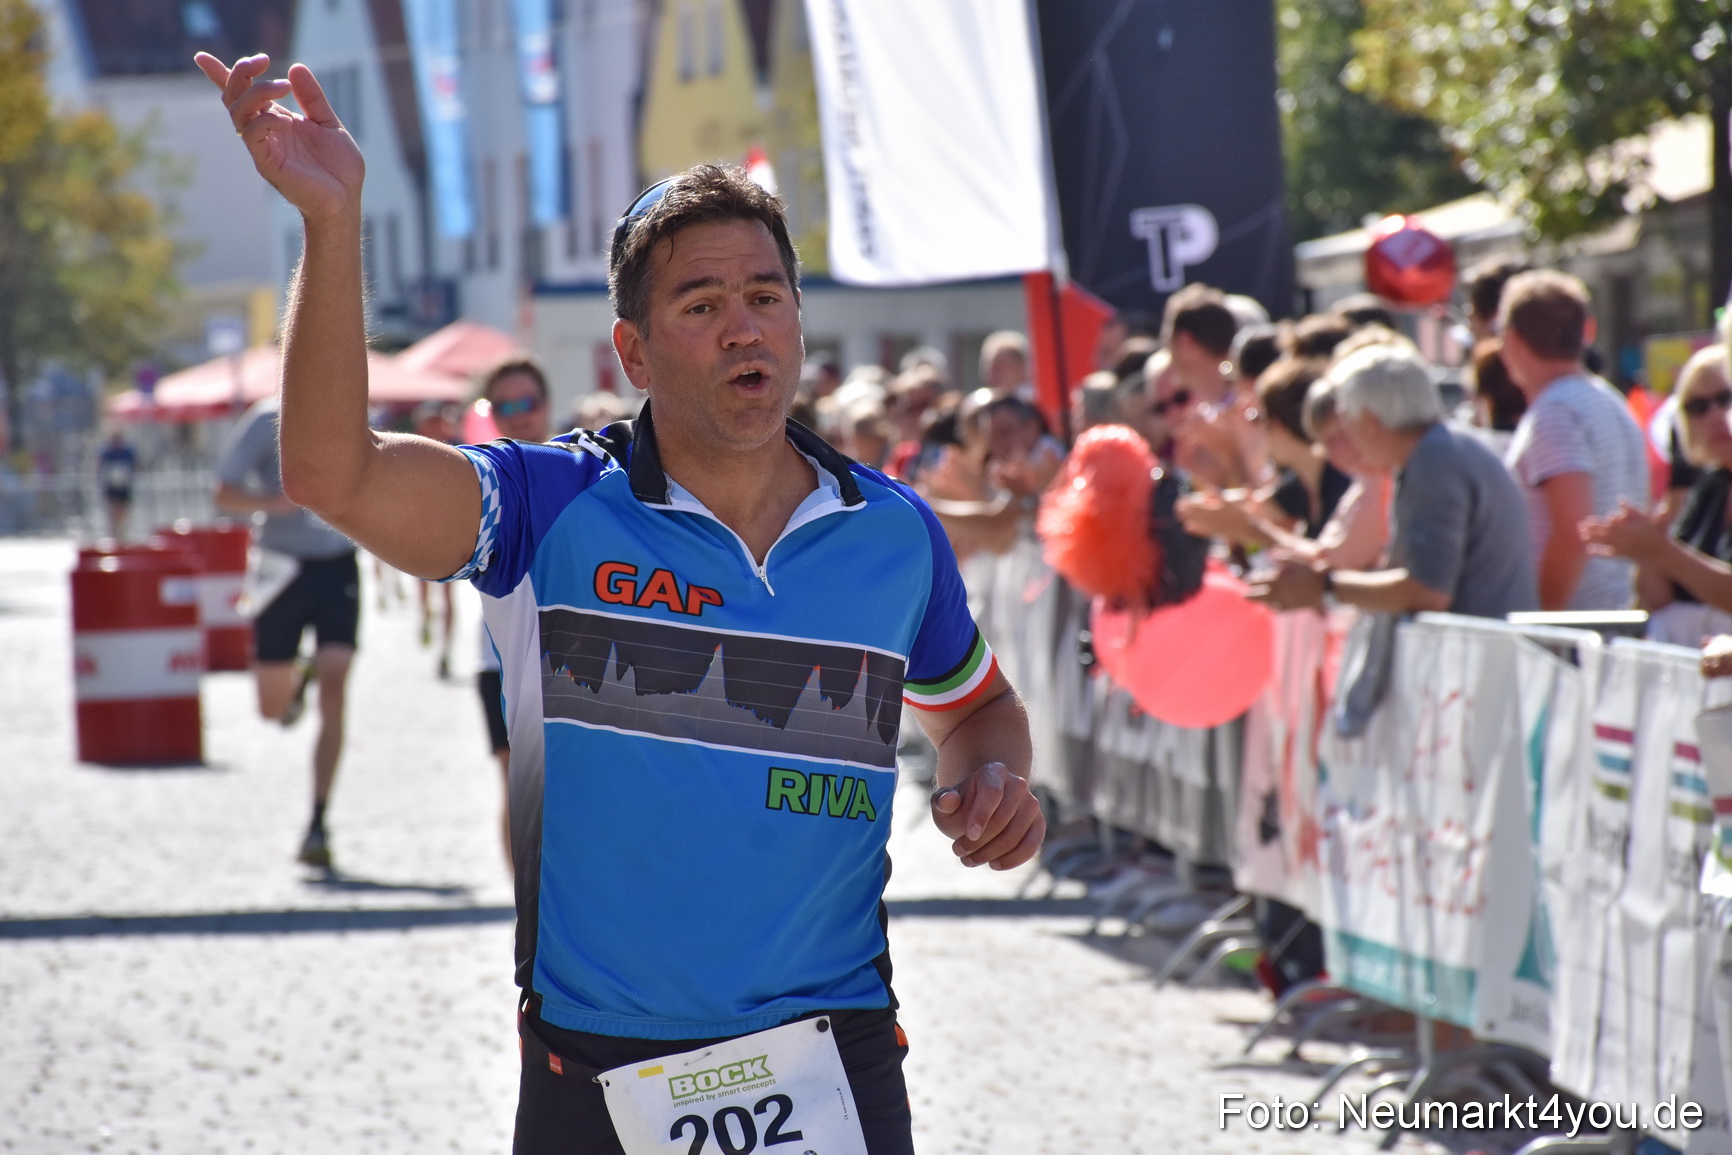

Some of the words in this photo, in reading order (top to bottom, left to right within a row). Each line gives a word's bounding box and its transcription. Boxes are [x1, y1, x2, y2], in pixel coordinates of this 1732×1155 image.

[593, 560, 725, 617] GAP
[766, 767, 877, 821] RIVA
[668, 1054, 774, 1100] BOCK
[673, 1093, 705, 1108] inspired
[706, 1093, 717, 1102] by
[717, 1087, 741, 1099] smart
[742, 1077, 777, 1093] concepts
[670, 1093, 804, 1155] 202
